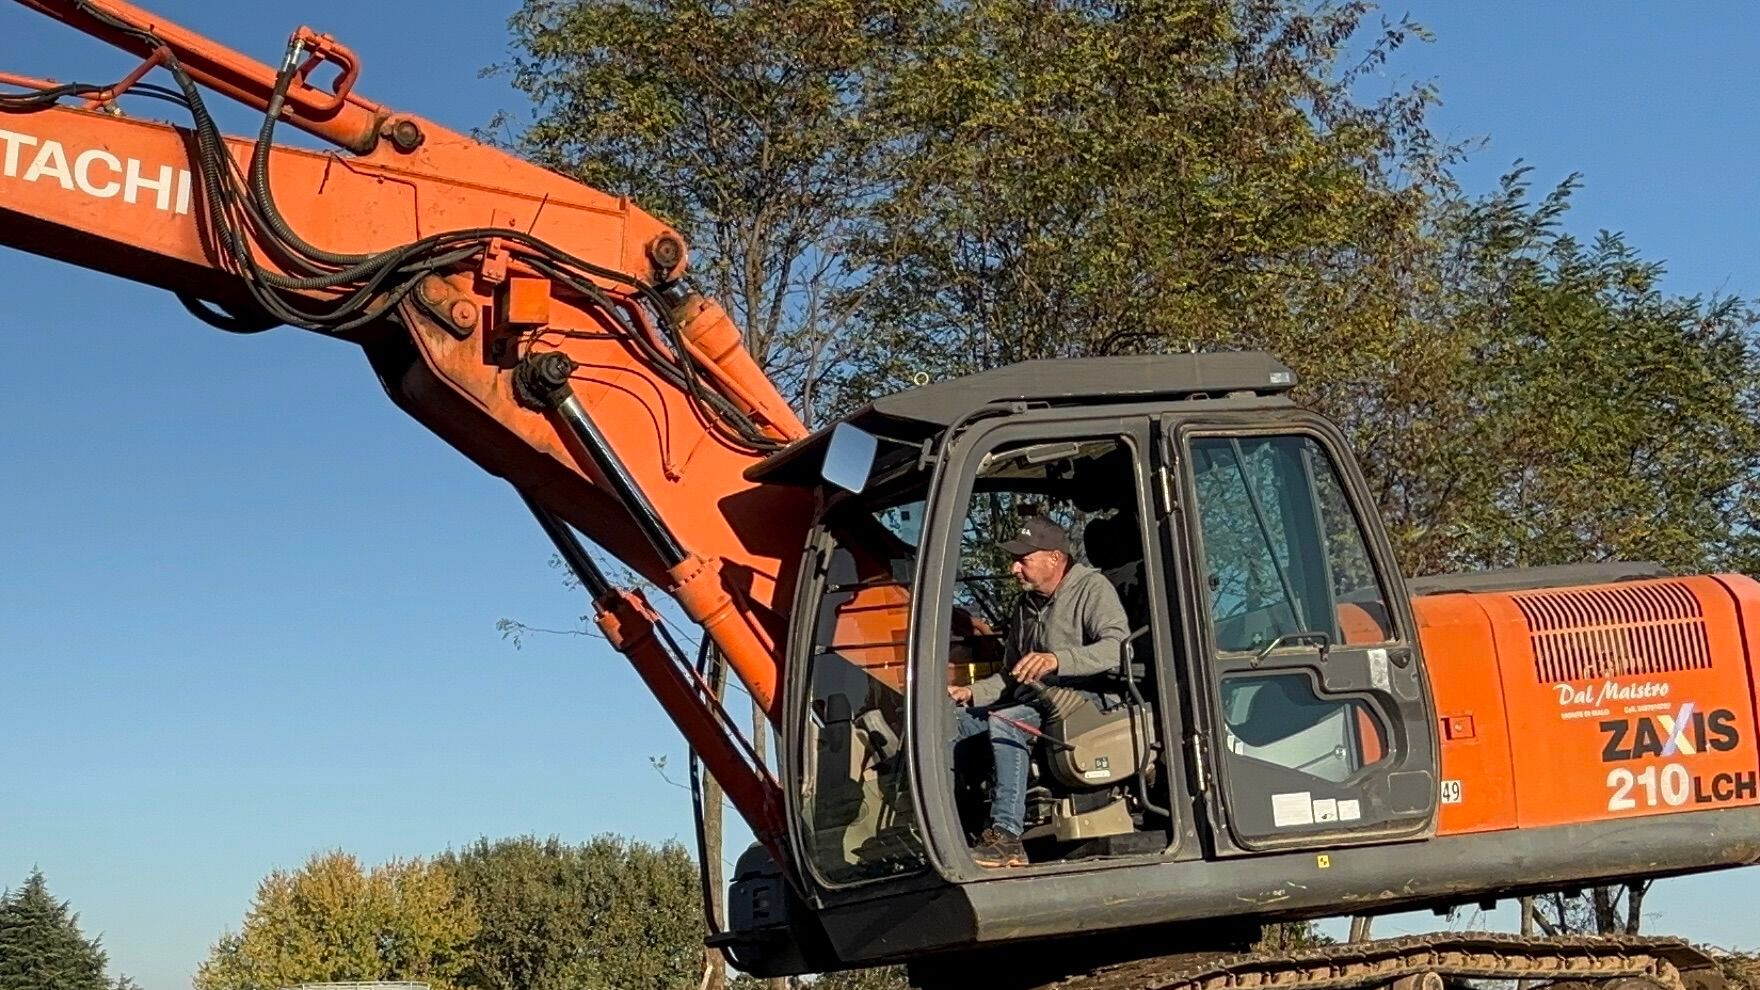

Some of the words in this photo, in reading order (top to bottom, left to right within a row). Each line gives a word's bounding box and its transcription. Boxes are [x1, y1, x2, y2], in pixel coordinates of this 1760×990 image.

[1553, 683, 1594, 705] Dal
[1595, 680, 1670, 706] Maistro
[1599, 702, 1740, 763] ZAXIS
[1443, 781, 1460, 801] 49
[1606, 763, 1690, 812] 210
[1693, 771, 1758, 803] LCH
